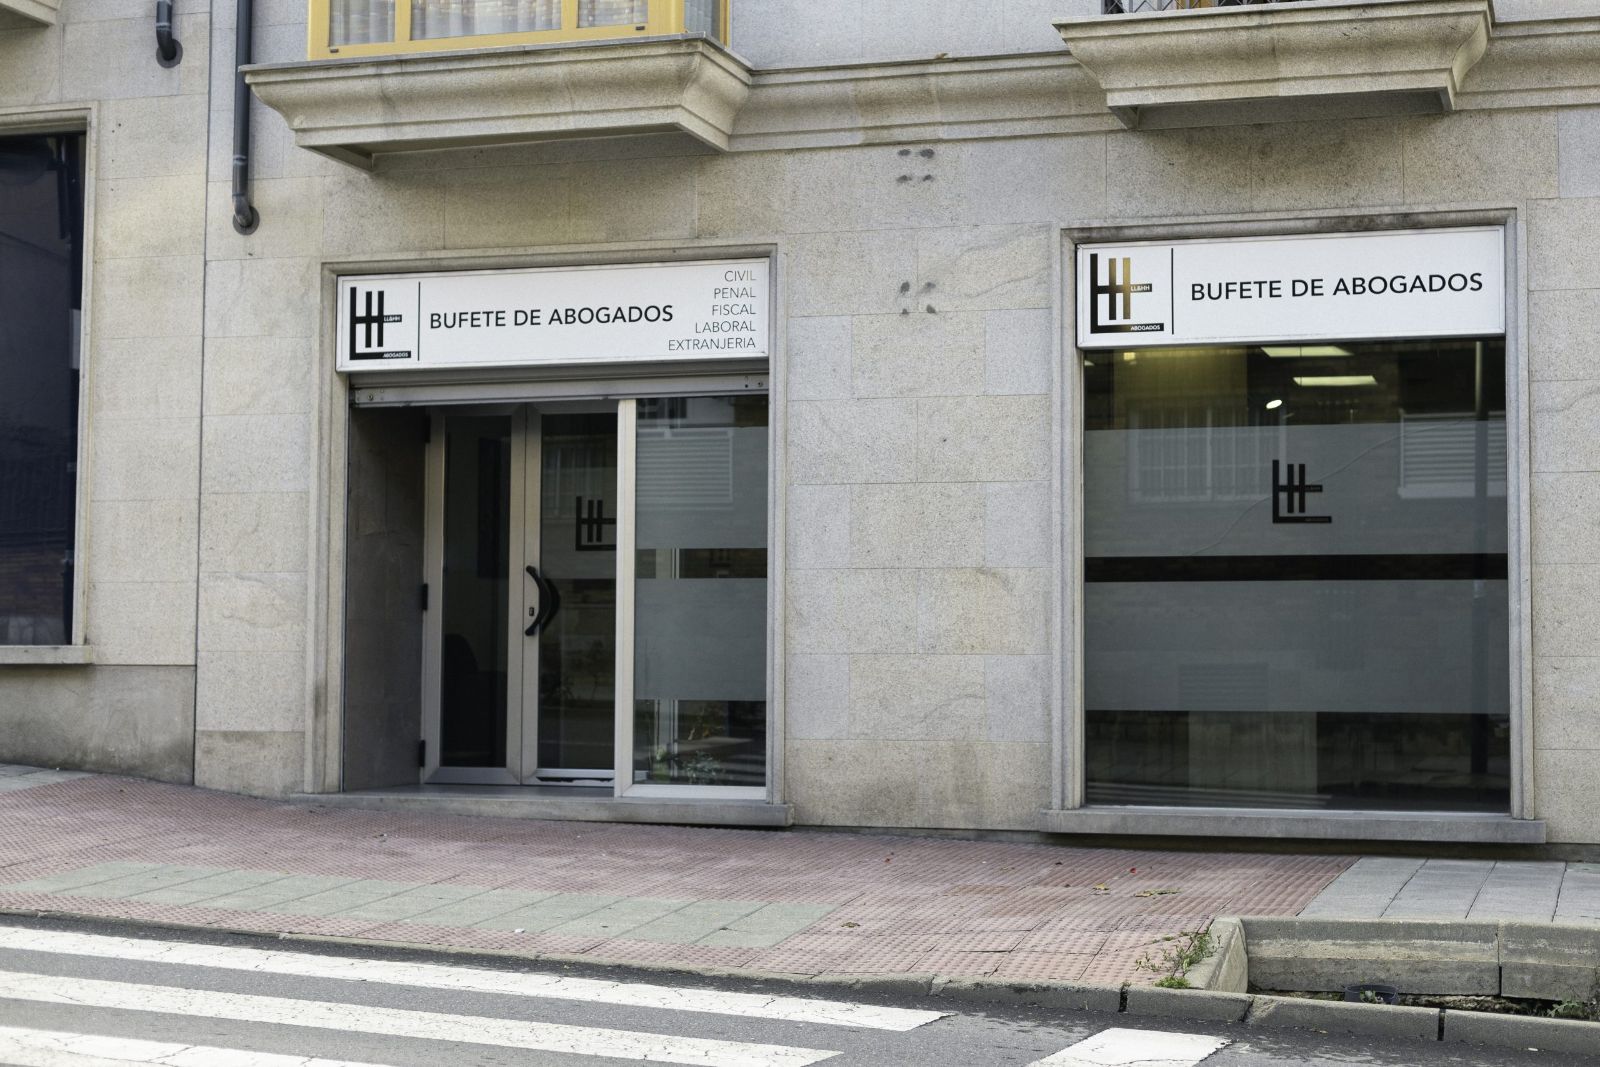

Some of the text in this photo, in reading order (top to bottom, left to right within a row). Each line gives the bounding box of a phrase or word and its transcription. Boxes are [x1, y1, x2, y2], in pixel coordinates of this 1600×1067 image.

[724, 270, 756, 282] CIVIL
[713, 287, 756, 299] PENAL
[1191, 272, 1483, 301] BUFETE DE ABOGADOS
[712, 303, 756, 316] FISCAL
[430, 305, 673, 329] BUFETE DE ABOGADOS
[695, 320, 756, 333] LABORAL
[668, 337, 756, 351] EXTRANJERIA
